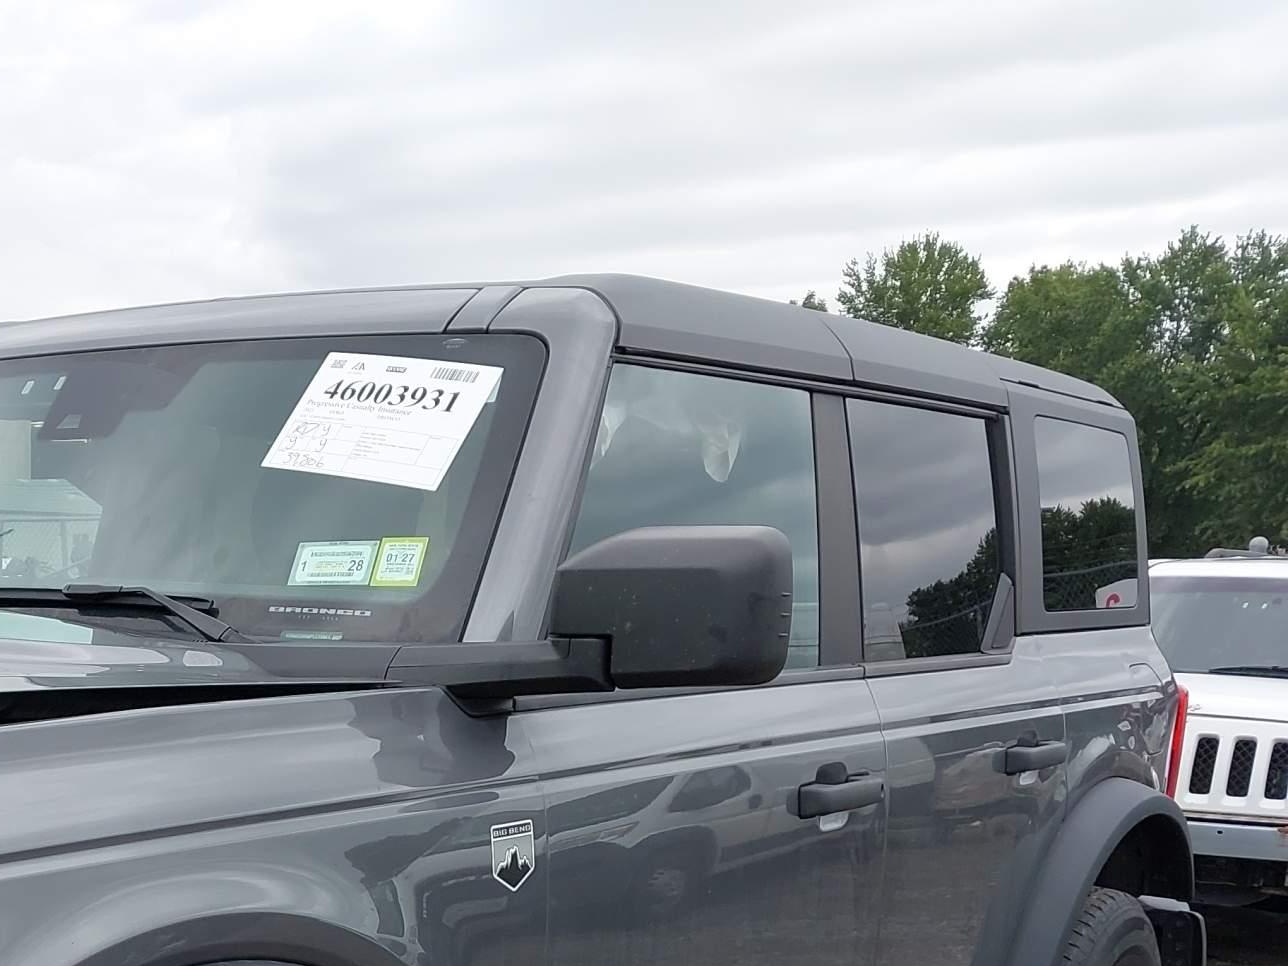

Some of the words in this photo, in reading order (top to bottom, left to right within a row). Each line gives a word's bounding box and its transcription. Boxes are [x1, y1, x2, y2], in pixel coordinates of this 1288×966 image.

[324, 379, 461, 413] 46003931
[401, 553, 416, 563] 27
[300, 560, 308, 572] 1
[348, 559, 364, 572] 28
[268, 606, 372, 617] BRONCO
[493, 829, 508, 837] BIG
[508, 825, 531, 834] BEND
